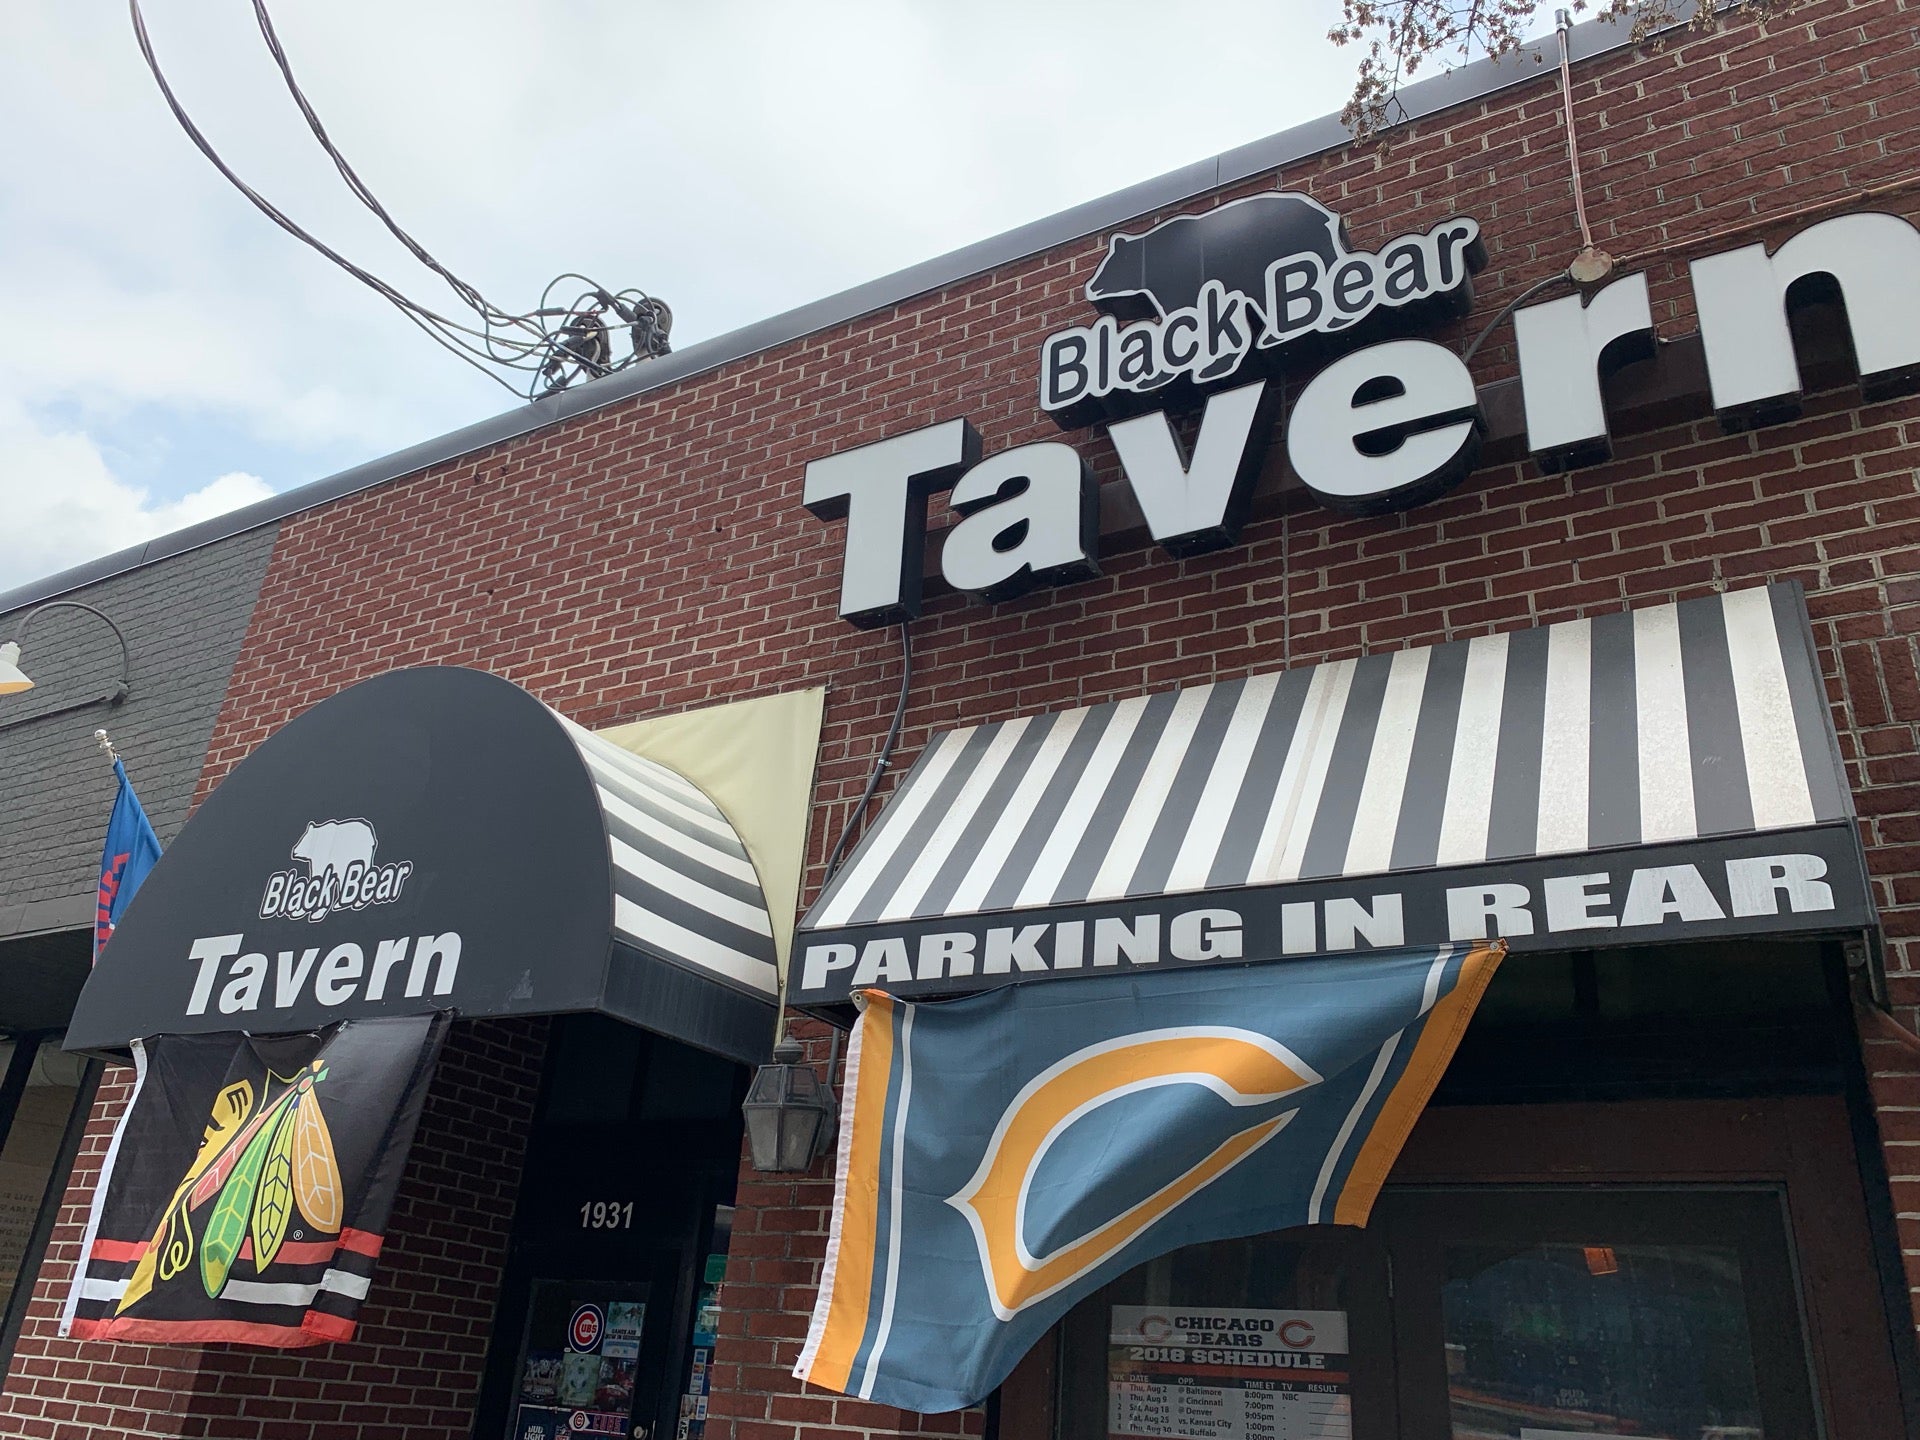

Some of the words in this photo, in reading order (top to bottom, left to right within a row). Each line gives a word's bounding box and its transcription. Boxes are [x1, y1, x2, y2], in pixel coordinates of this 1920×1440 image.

[1047, 285, 1248, 408] Black
[1274, 224, 1471, 335] Bear
[802, 211, 1920, 619] Tavern
[262, 863, 338, 917] Black
[340, 862, 411, 907] Bear
[801, 907, 1244, 990] PARKING
[1280, 892, 1406, 956] IN
[1445, 852, 1836, 942] REAR
[185, 931, 463, 1016] Tavern
[579, 1201, 634, 1230] 1931
[1174, 1316, 1275, 1332] CHICAGO
[1185, 1331, 1264, 1348] BEARS
[1129, 1347, 1186, 1363] 2018
[1191, 1348, 1325, 1369] SCHEDULE
[1130, 1374, 1149, 1383] DATE
[1177, 1376, 1196, 1385] OPP.
[1244, 1380, 1264, 1389] TIME
[1281, 1382, 1293, 1391] TV
[1308, 1384, 1339, 1393] RESULT
[1146, 1385, 1161, 1394] Aug
[1162, 1385, 1167, 1393] 2
[1186, 1387, 1222, 1396] Baltimore
[1244, 1390, 1274, 1400] 8:00pm
[1281, 1392, 1300, 1401] NBC
[1144, 1404, 1159, 1413] Aug
[1186, 1407, 1213, 1416] Denver
[1244, 1412, 1275, 1421] 9:05pm
[1146, 1395, 1161, 1404] Aug
[1162, 1395, 1167, 1403] 9
[1186, 1397, 1224, 1407] Cincinnati
[1244, 1401, 1274, 1411] 7:00pm
[1144, 1414, 1159, 1424] Aug
[1160, 1415, 1170, 1423] 25
[1189, 1418, 1216, 1427] Kansas
[1216, 1419, 1232, 1429] City
[1245, 1422, 1275, 1432] 1:00pm
[1189, 1427, 1217, 1437] Buffalo
